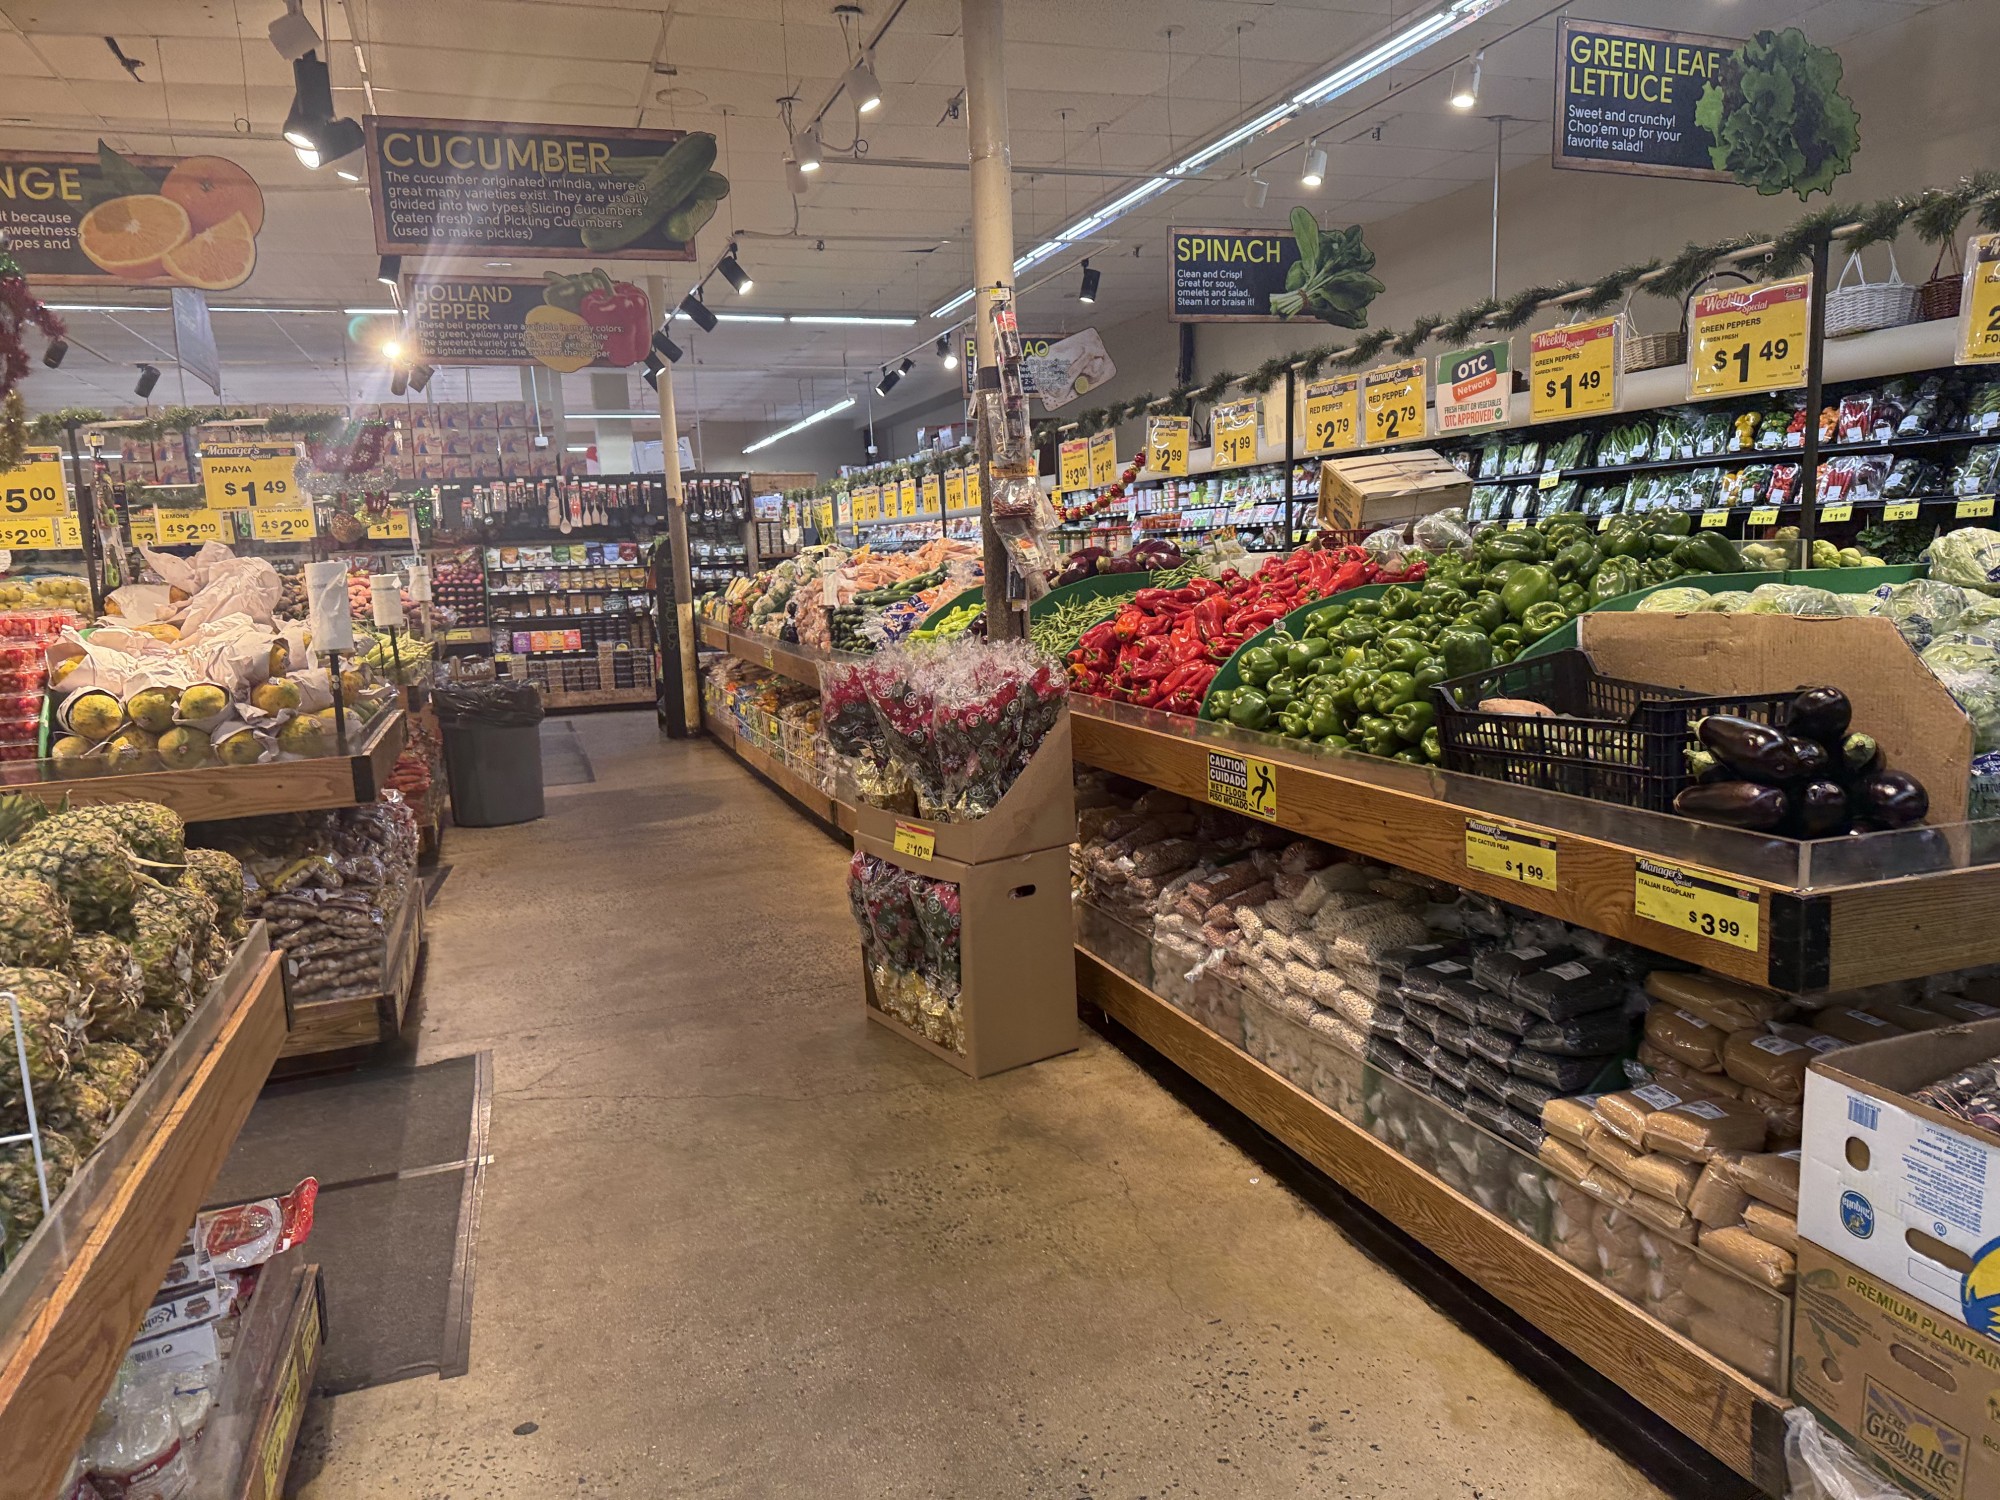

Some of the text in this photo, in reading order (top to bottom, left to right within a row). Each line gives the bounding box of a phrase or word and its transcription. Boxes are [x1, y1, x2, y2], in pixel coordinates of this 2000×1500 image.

[1571, 36, 1720, 79] GREEN LEAF
[1570, 66, 1672, 103] LETTUCE
[1569, 105, 1676, 129] Sweet and crunchy!
[1622, 127, 1636, 139] up
[1639, 126, 1655, 139] for
[1657, 131, 1681, 142] your
[1568, 135, 1643, 153] favorite salad!
[384, 133, 613, 174] CUCUMBER
[386, 171, 646, 191] The cucumber originated in India, where a
[389, 187, 649, 206] great many varieties exist. They are usually
[390, 199, 435, 211] divided
[439, 200, 463, 212] into
[466, 201, 488, 213] two
[532, 203, 571, 216] Slicing
[574, 204, 643, 217] Cucumbers
[12, 210, 71, 223] because
[391, 212, 624, 229] (eaten fresh) and Pickling Cucumbers
[393, 225, 533, 241] (used to make pickles)
[44, 238, 71, 249] and
[1177, 238, 1281, 263] SPINACH
[1177, 270, 1201, 278] Clean
[1220, 271, 1243, 281] Crisp!
[1177, 279, 1200, 287] Great
[1216, 281, 1237, 289] soup,
[415, 284, 512, 303] HOLLAND
[1177, 288, 1250, 297] omelets and salad.
[1177, 297, 1202, 305] Steam
[1703, 292, 1744, 312] Weekly
[1742, 300, 1768, 314] Special
[416, 304, 490, 320] PEPPER
[418, 321, 445, 329] These
[446, 321, 463, 329] bell
[465, 322, 501, 331] peppers
[1701, 318, 1761, 334] GREEN PEPPERS
[438, 339, 477, 347] sweetest
[479, 339, 507, 348] variety
[509, 340, 517, 348] is
[440, 331, 469, 340] green,
[471, 330, 500, 340] yellow,
[568, 333, 584, 341] and
[1537, 332, 1567, 349] Weekly
[1722, 333, 1738, 341] FRESH
[437, 347, 466, 356] lighter
[486, 348, 510, 357] color,
[1567, 338, 1585, 350] Special
[1458, 355, 1488, 379] OTC
[1535, 352, 1580, 367] GREEN PEPPERS
[1457, 378, 1491, 396] Network
[1369, 395, 1380, 404] RED
[1444, 398, 1501, 414] FRESH FRUIT OR VEGETABLES
[1310, 402, 1342, 414] RED PEPPER
[1445, 409, 1493, 427] OTC APPROVED!
[207, 445, 260, 457] Manager's
[212, 466, 252, 474] PAPAYA
[167, 525, 174, 533] 4
[261, 521, 269, 529] 4
[1210, 754, 1246, 773] CAUTION
[1210, 768, 1247, 788] CUIDADO
[1210, 782, 1246, 800] WET FLOOR
[1209, 792, 1248, 810] PISO MOJADO
[1469, 820, 1500, 835] Manager's
[1478, 838, 1496, 848] CACTUS
[1497, 843, 1509, 851] PEAR
[1640, 860, 1683, 880] Manager's
[1638, 878, 1696, 900] ITALIAN EGGPLANT
[1674, 878, 1692, 888] Special
[1842, 1197, 1872, 1221] Chiquita
[1846, 1276, 1918, 1326] PREMIUM
